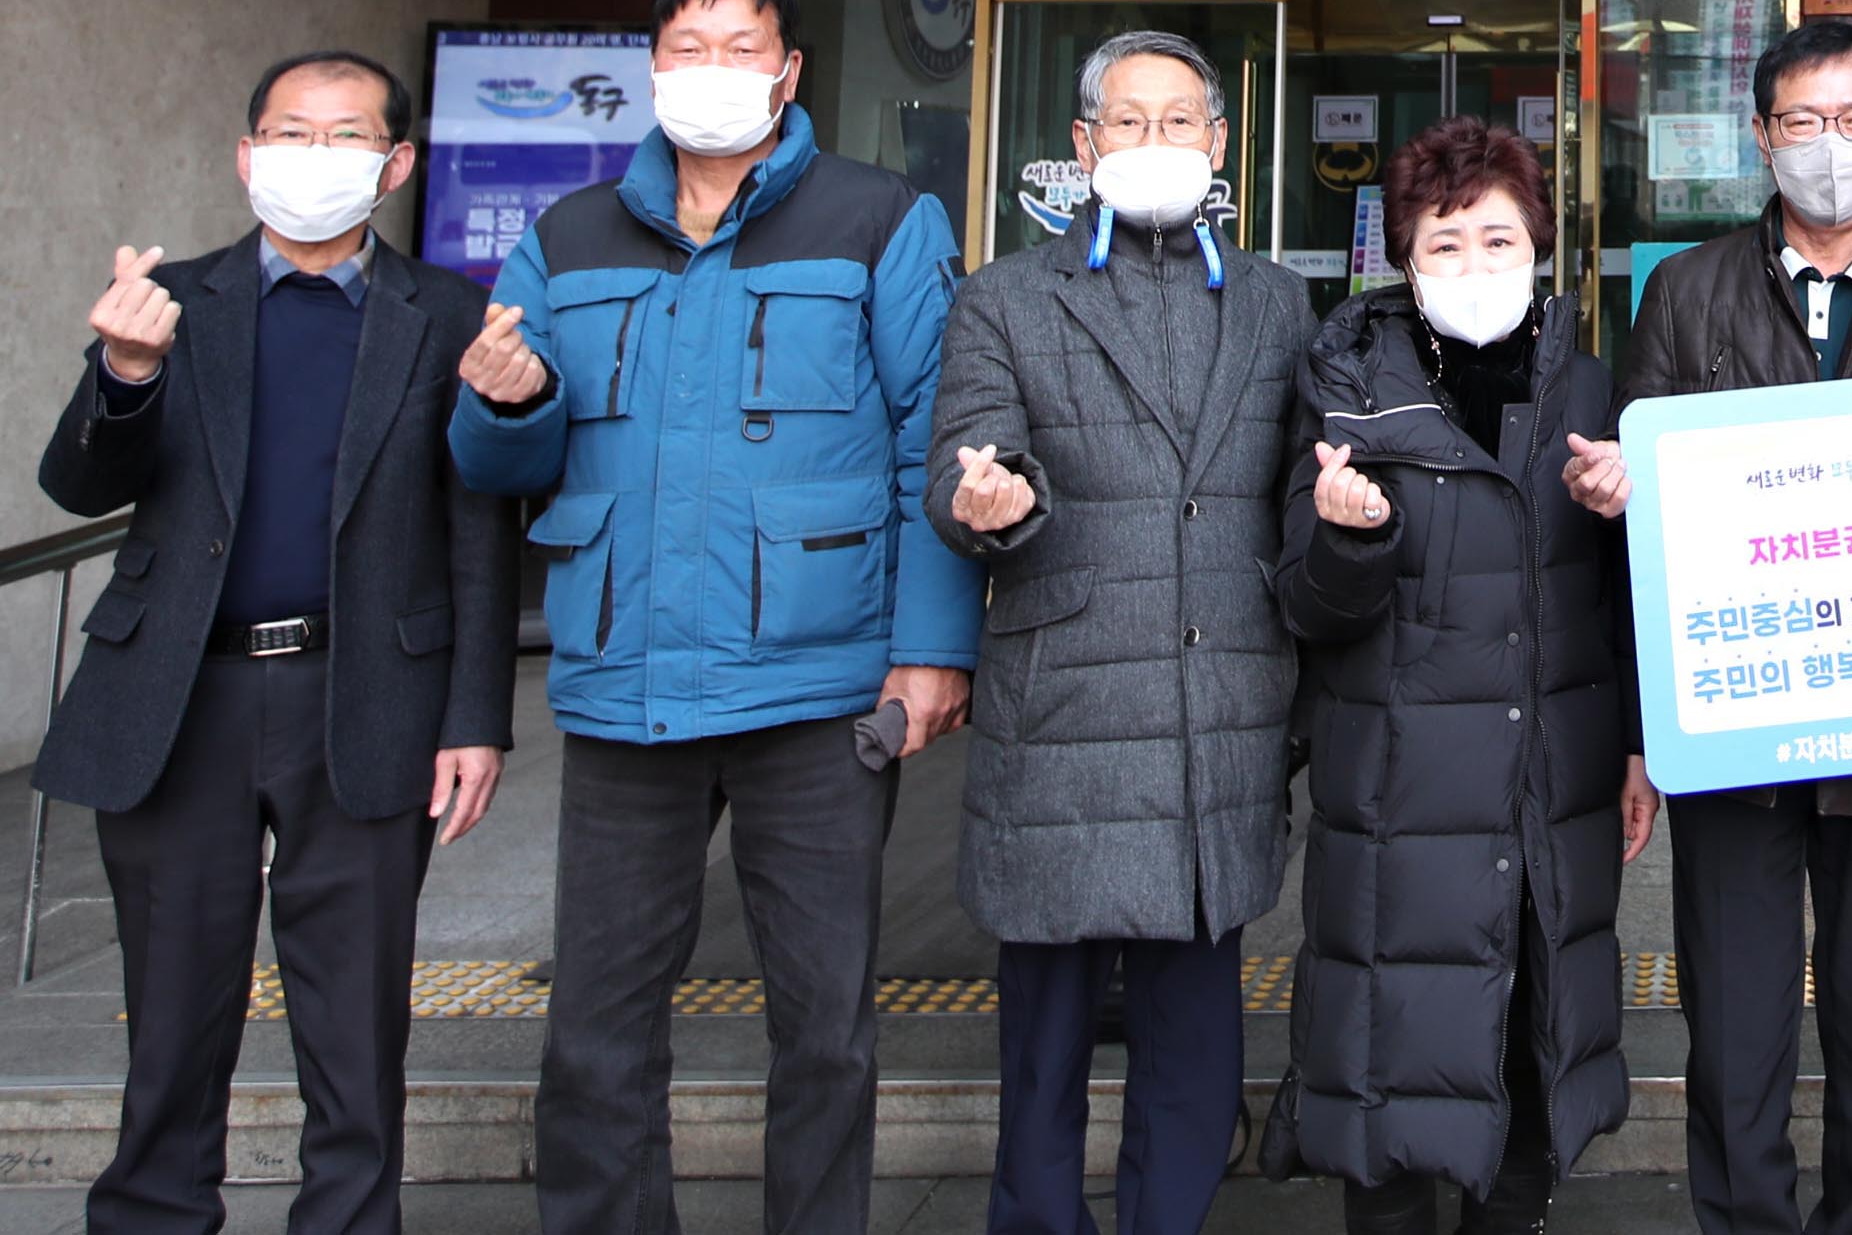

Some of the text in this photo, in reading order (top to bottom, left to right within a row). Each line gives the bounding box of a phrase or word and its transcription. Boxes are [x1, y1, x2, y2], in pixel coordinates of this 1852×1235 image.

[570, 74, 629, 122] 동구
[1686, 594, 1842, 645] 주민중심의
[1692, 660, 1791, 704] 주민의
